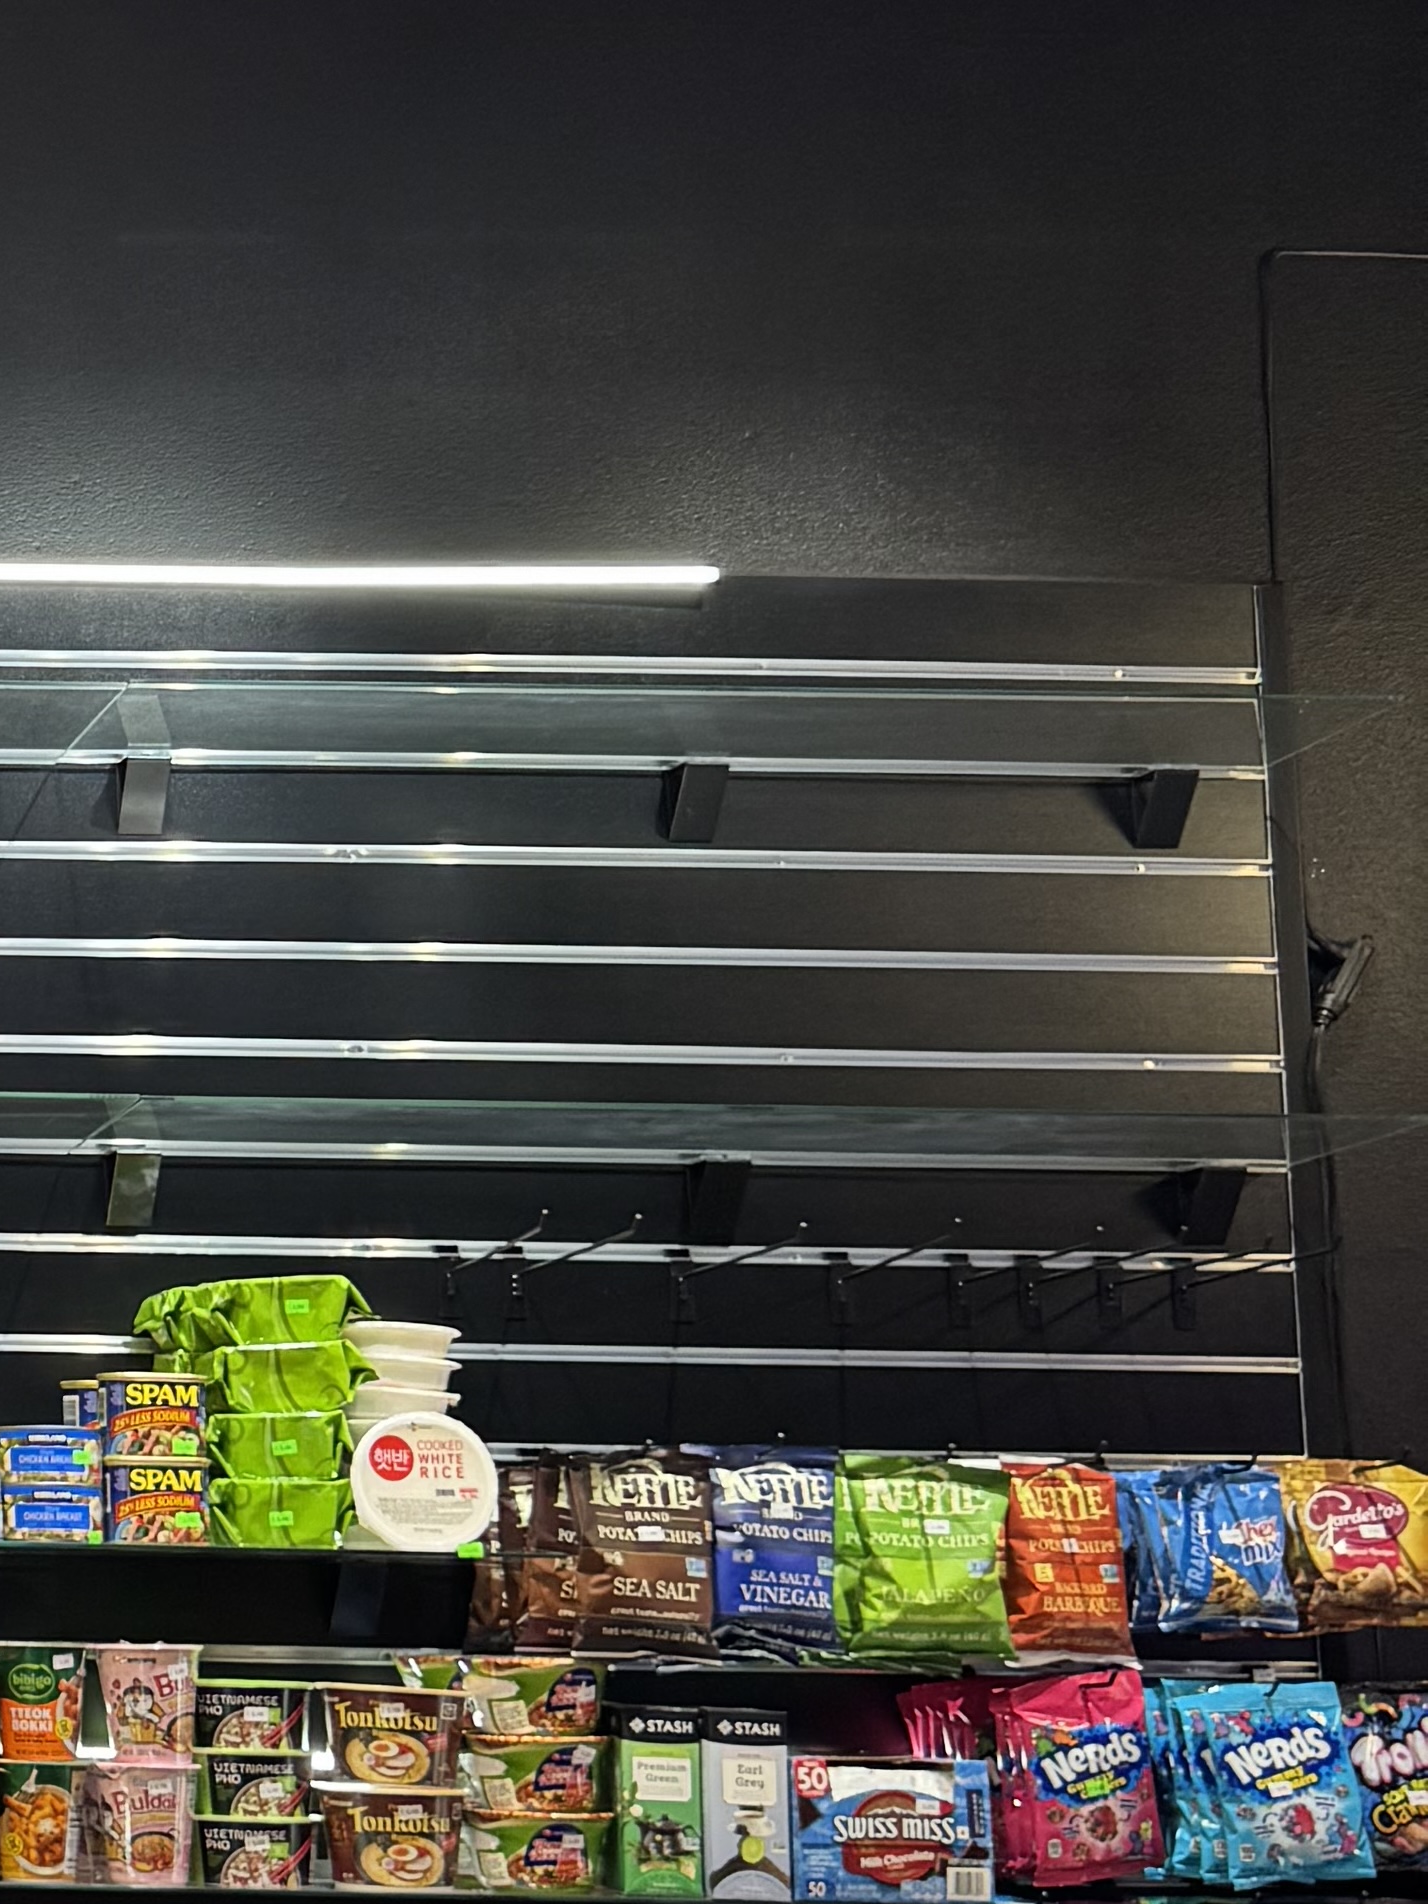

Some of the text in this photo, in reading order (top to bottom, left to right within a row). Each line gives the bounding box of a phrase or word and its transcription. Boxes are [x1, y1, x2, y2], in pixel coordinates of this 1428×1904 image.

[126, 1383, 199, 1406] SPAM
[417, 1440, 463, 1451] COOKED
[374, 1446, 409, 1473] 햇반
[418, 1454, 463, 1465] WHITE
[129, 1468, 202, 1491] SPAM
[419, 1467, 465, 1479] RICE
[590, 1464, 702, 1507] KETTLE
[1013, 1471, 1110, 1521] KETTLE
[625, 1511, 670, 1523] BRAND
[613, 1577, 700, 1603] SEA SALT
[739, 1586, 831, 1609] VINEGAR
[12, 1672, 52, 1688] bibigo
[198, 1694, 278, 1707] VIETNAMESE
[10, 1707, 52, 1720] TTEOK
[199, 1706, 223, 1715] PHO
[646, 1718, 694, 1734] STASH
[733, 1720, 781, 1736] STASH
[213, 1762, 294, 1774] VIETNAMESE
[636, 1762, 688, 1773] Premium
[738, 1765, 764, 1775] Earl
[215, 1774, 241, 1784] PHO
[644, 1772, 680, 1784] Green
[735, 1776, 766, 1790] Grey
[796, 1766, 827, 1791] 50
[204, 1828, 286, 1841] VIETNAMESE
[833, 1815, 955, 1843] SWISS MISS
[204, 1839, 230, 1851] PHO
[859, 1851, 936, 1869] Milk Chocolate
